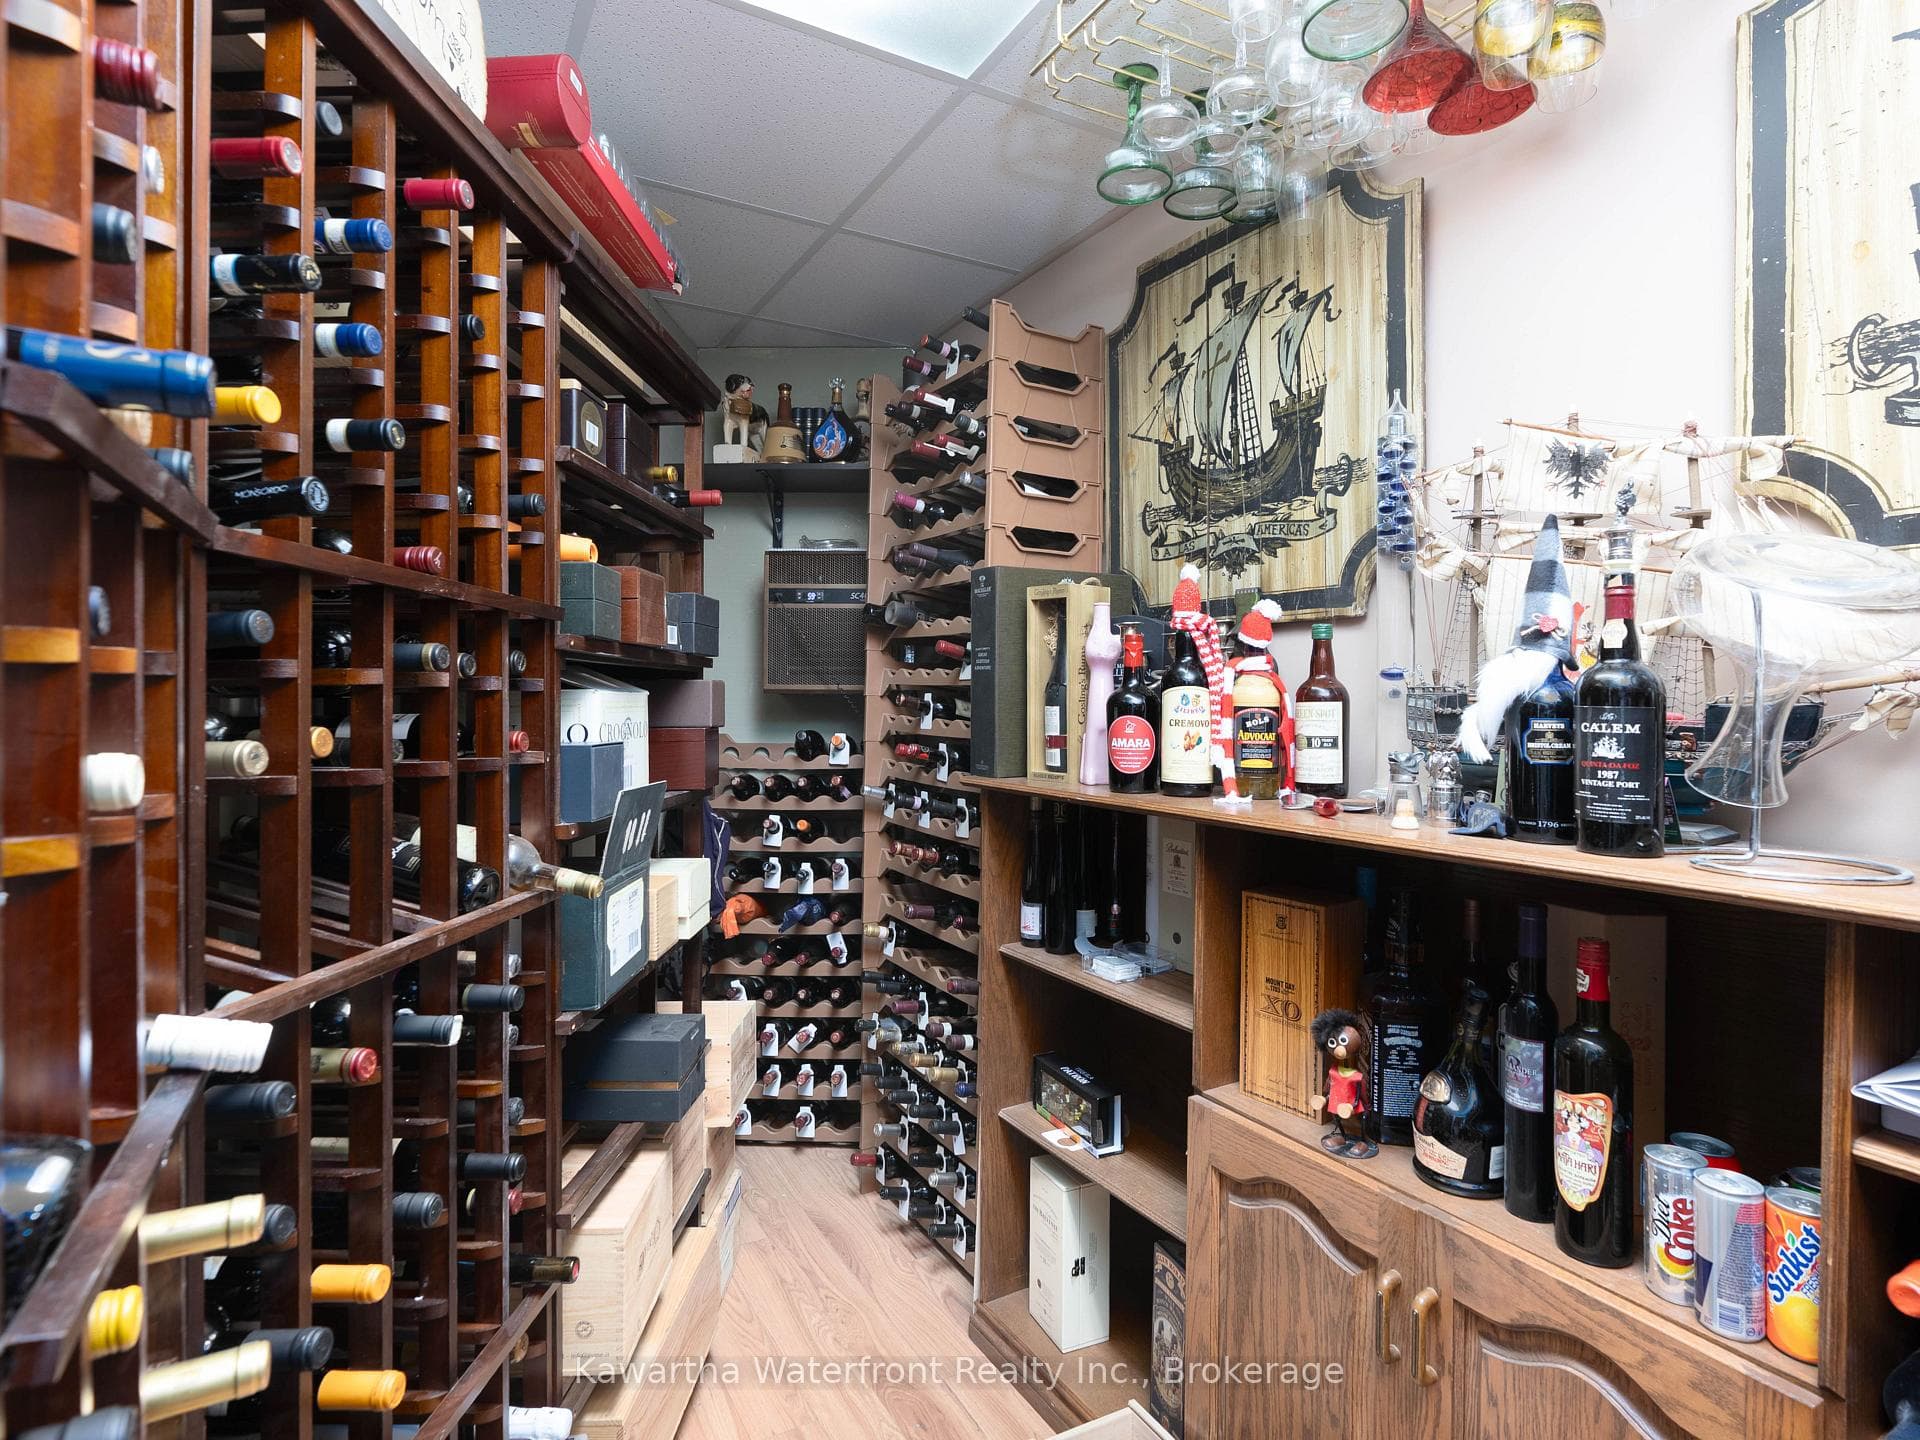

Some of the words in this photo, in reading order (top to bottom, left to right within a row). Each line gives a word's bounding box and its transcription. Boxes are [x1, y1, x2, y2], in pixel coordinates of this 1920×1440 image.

[1163, 549, 1172, 557] A
[1178, 541, 1195, 554] LAS
[1255, 522, 1310, 536] AMERICAS
[849, 592, 866, 600] SC4
[1169, 718, 1210, 728] CREMOVO
[1245, 715, 1270, 728] BOLS
[1237, 730, 1277, 741] ADVOCAAT
[1111, 737, 1151, 748] AMARA
[1311, 737, 1321, 748] 10
[1597, 770, 1619, 779] 1987
[1581, 778, 1615, 788] VINTAGE
[1616, 780, 1641, 789] PORT
[1538, 820, 1559, 828] 1796
[1258, 992, 1302, 1022] XO
[1574, 1159, 1598, 1175] HARI
[1652, 1195, 1672, 1242] Diet
[1664, 1197, 1695, 1267] Coke
[1767, 1223, 1821, 1304] Sunkist
